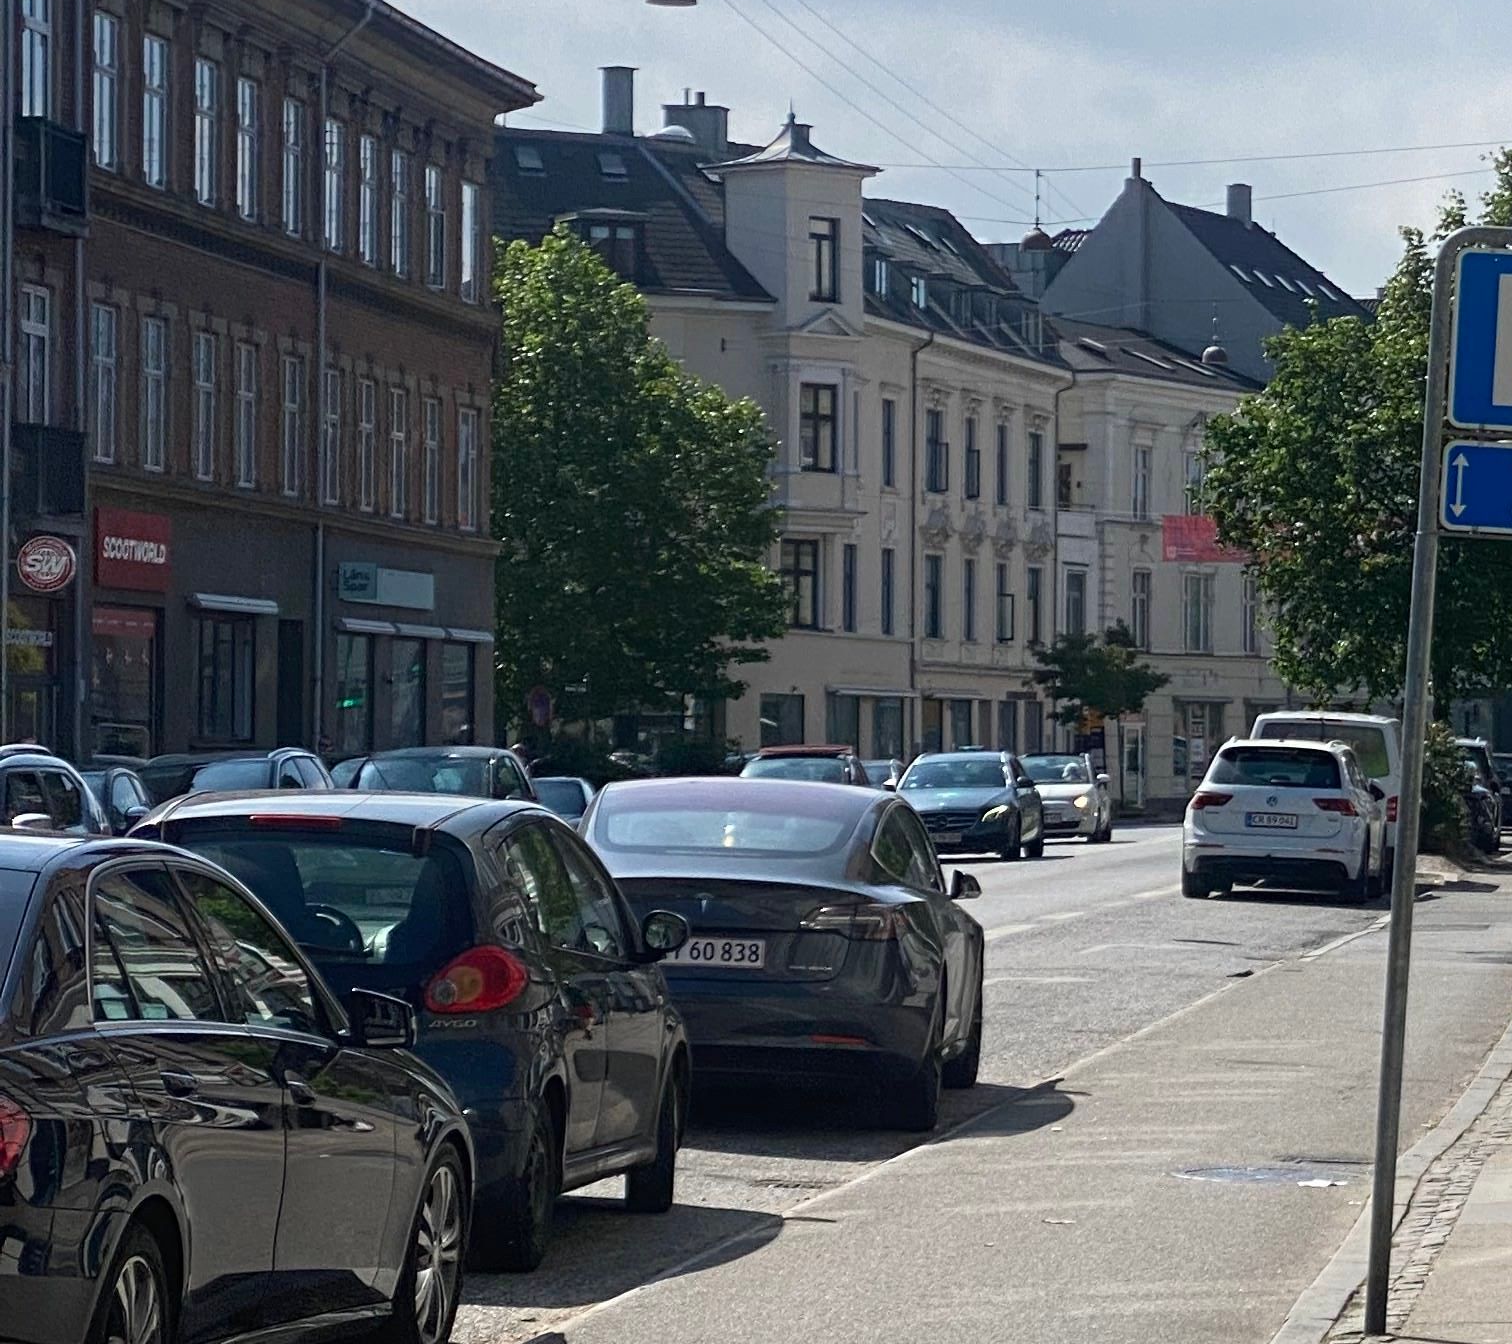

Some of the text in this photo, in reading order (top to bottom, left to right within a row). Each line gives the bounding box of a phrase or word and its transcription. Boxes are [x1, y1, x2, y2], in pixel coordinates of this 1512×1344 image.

[103, 535, 166, 565] SCOOTWORLD
[24, 554, 68, 573] SW
[690, 941, 714, 960] 60
[721, 942, 760, 963] 838
